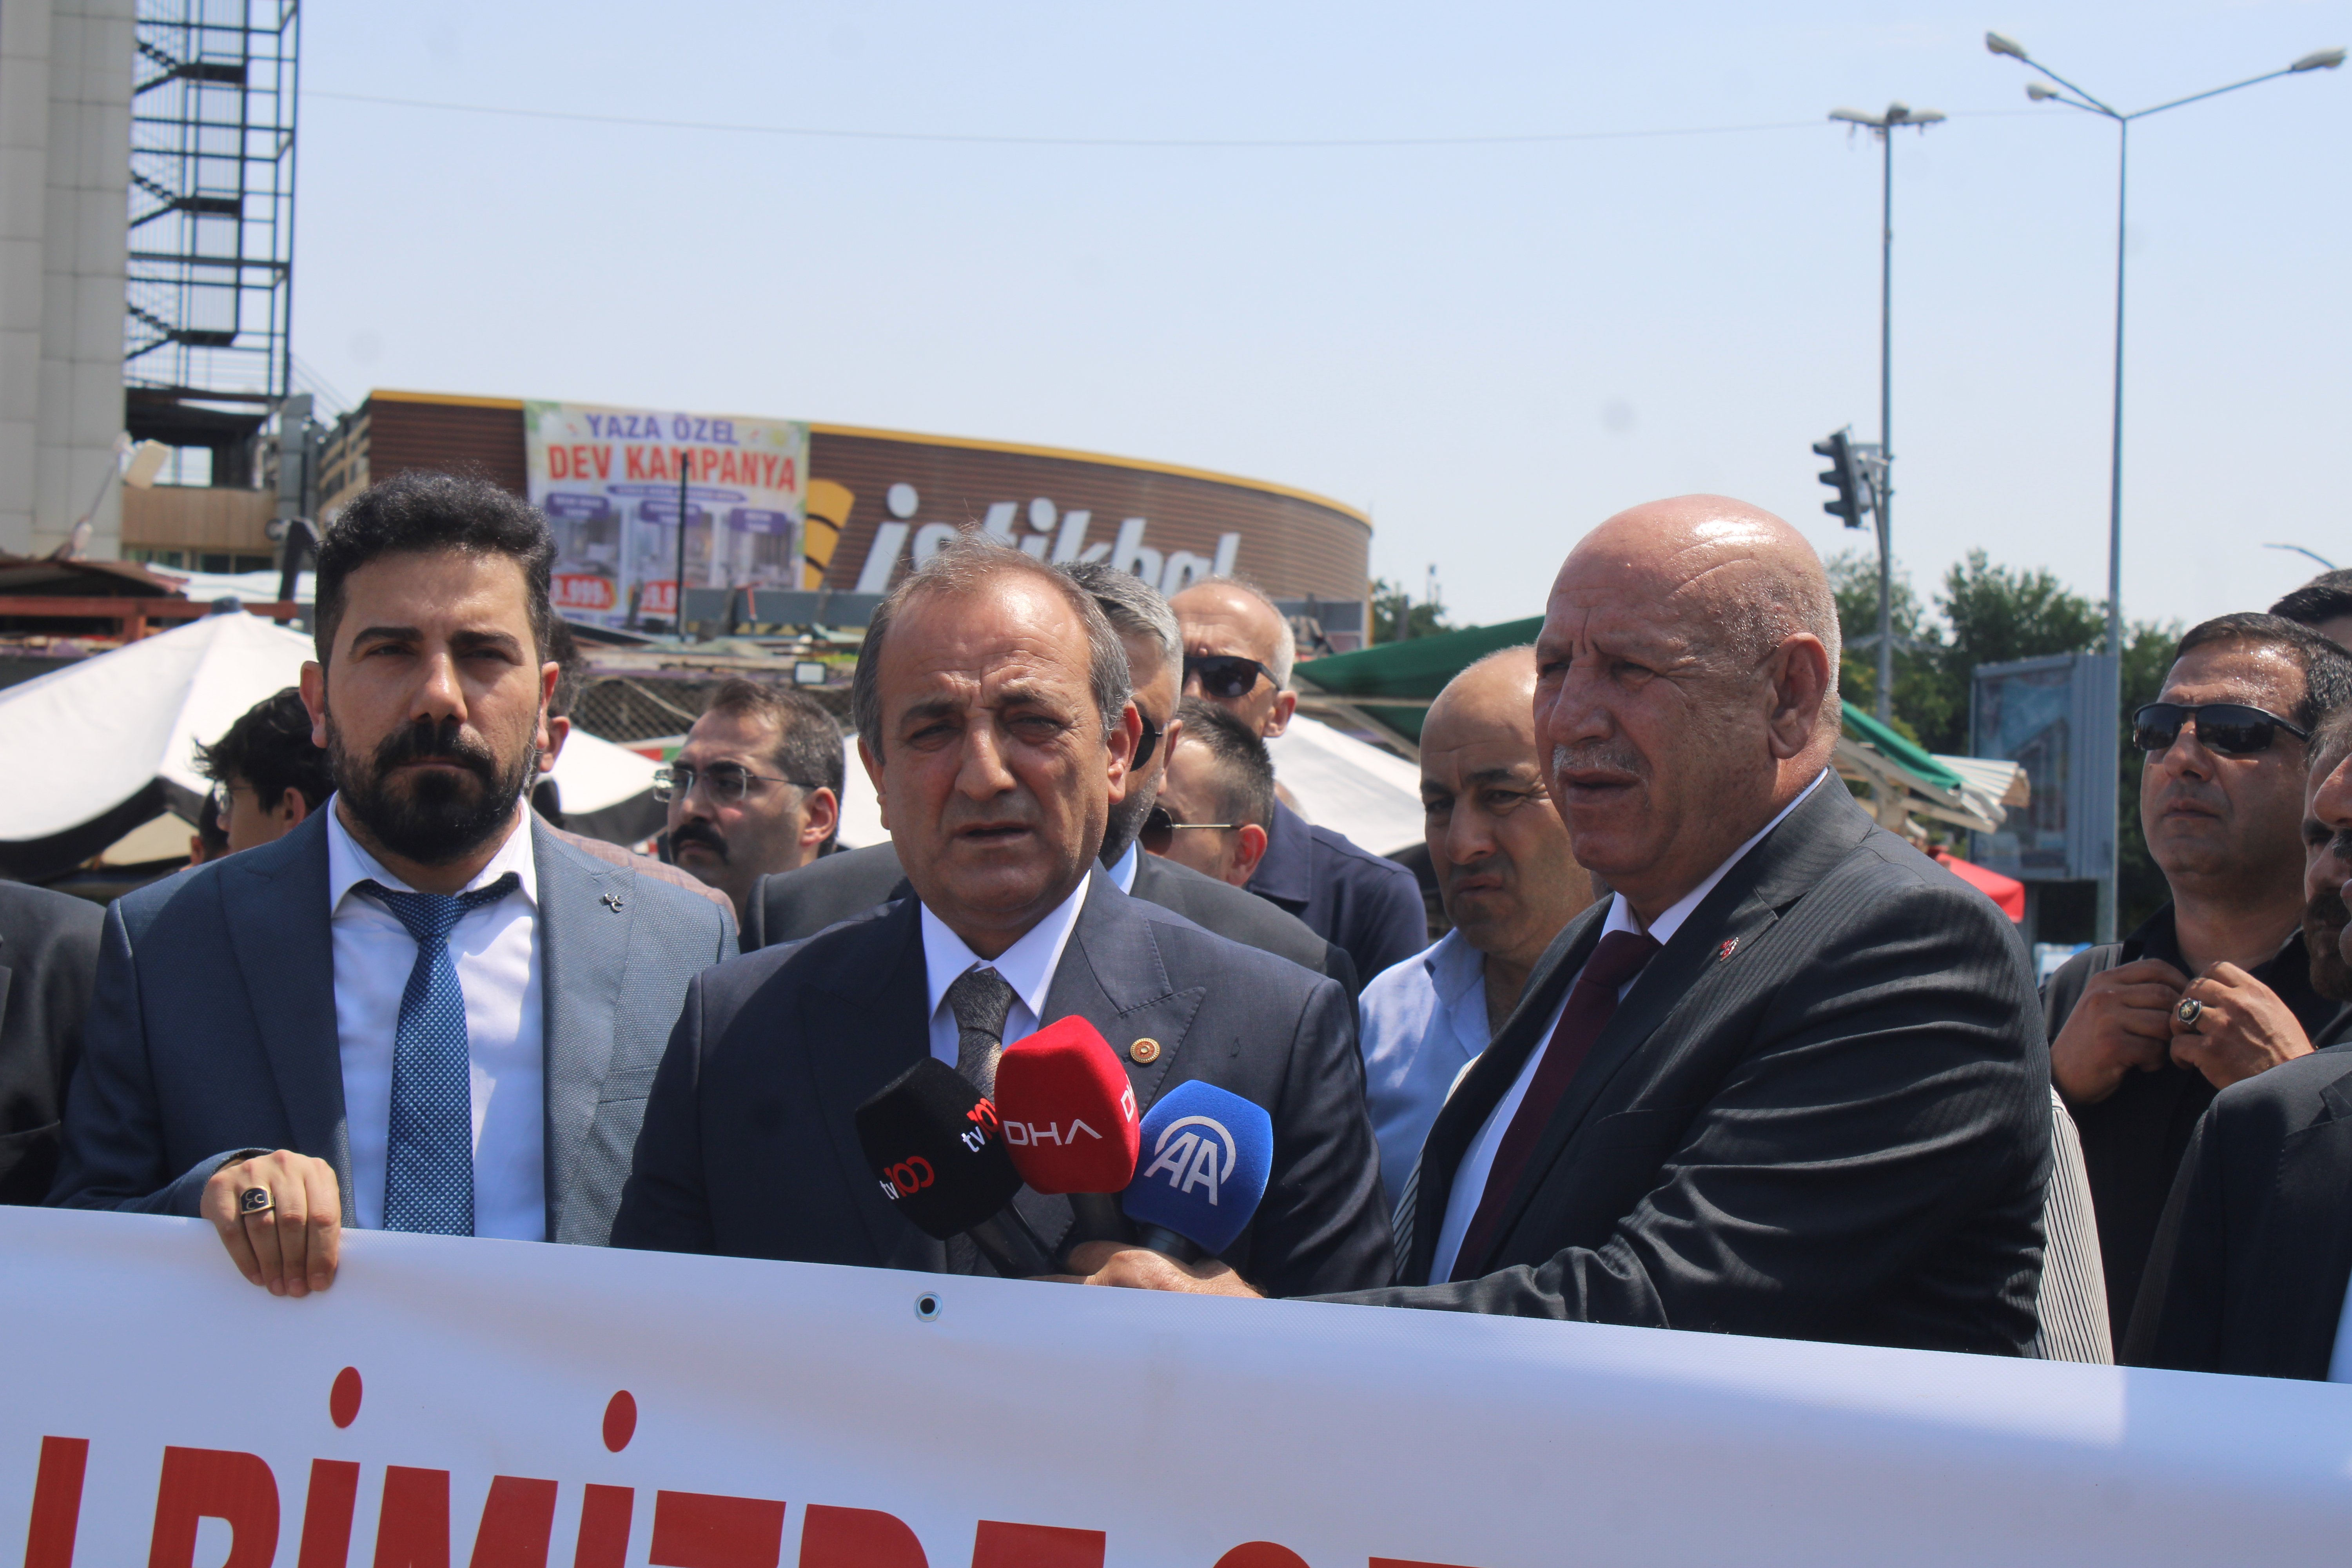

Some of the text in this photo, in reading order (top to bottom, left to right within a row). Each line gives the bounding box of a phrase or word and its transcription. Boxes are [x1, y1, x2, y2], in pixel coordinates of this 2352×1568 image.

[586, 414, 738, 445] YAZA ÖZEL
[550, 445, 796, 492] DEV KAMPANYA
[1003, 1119, 1103, 1146] DHA
[1143, 1131, 1218, 1205] AA
